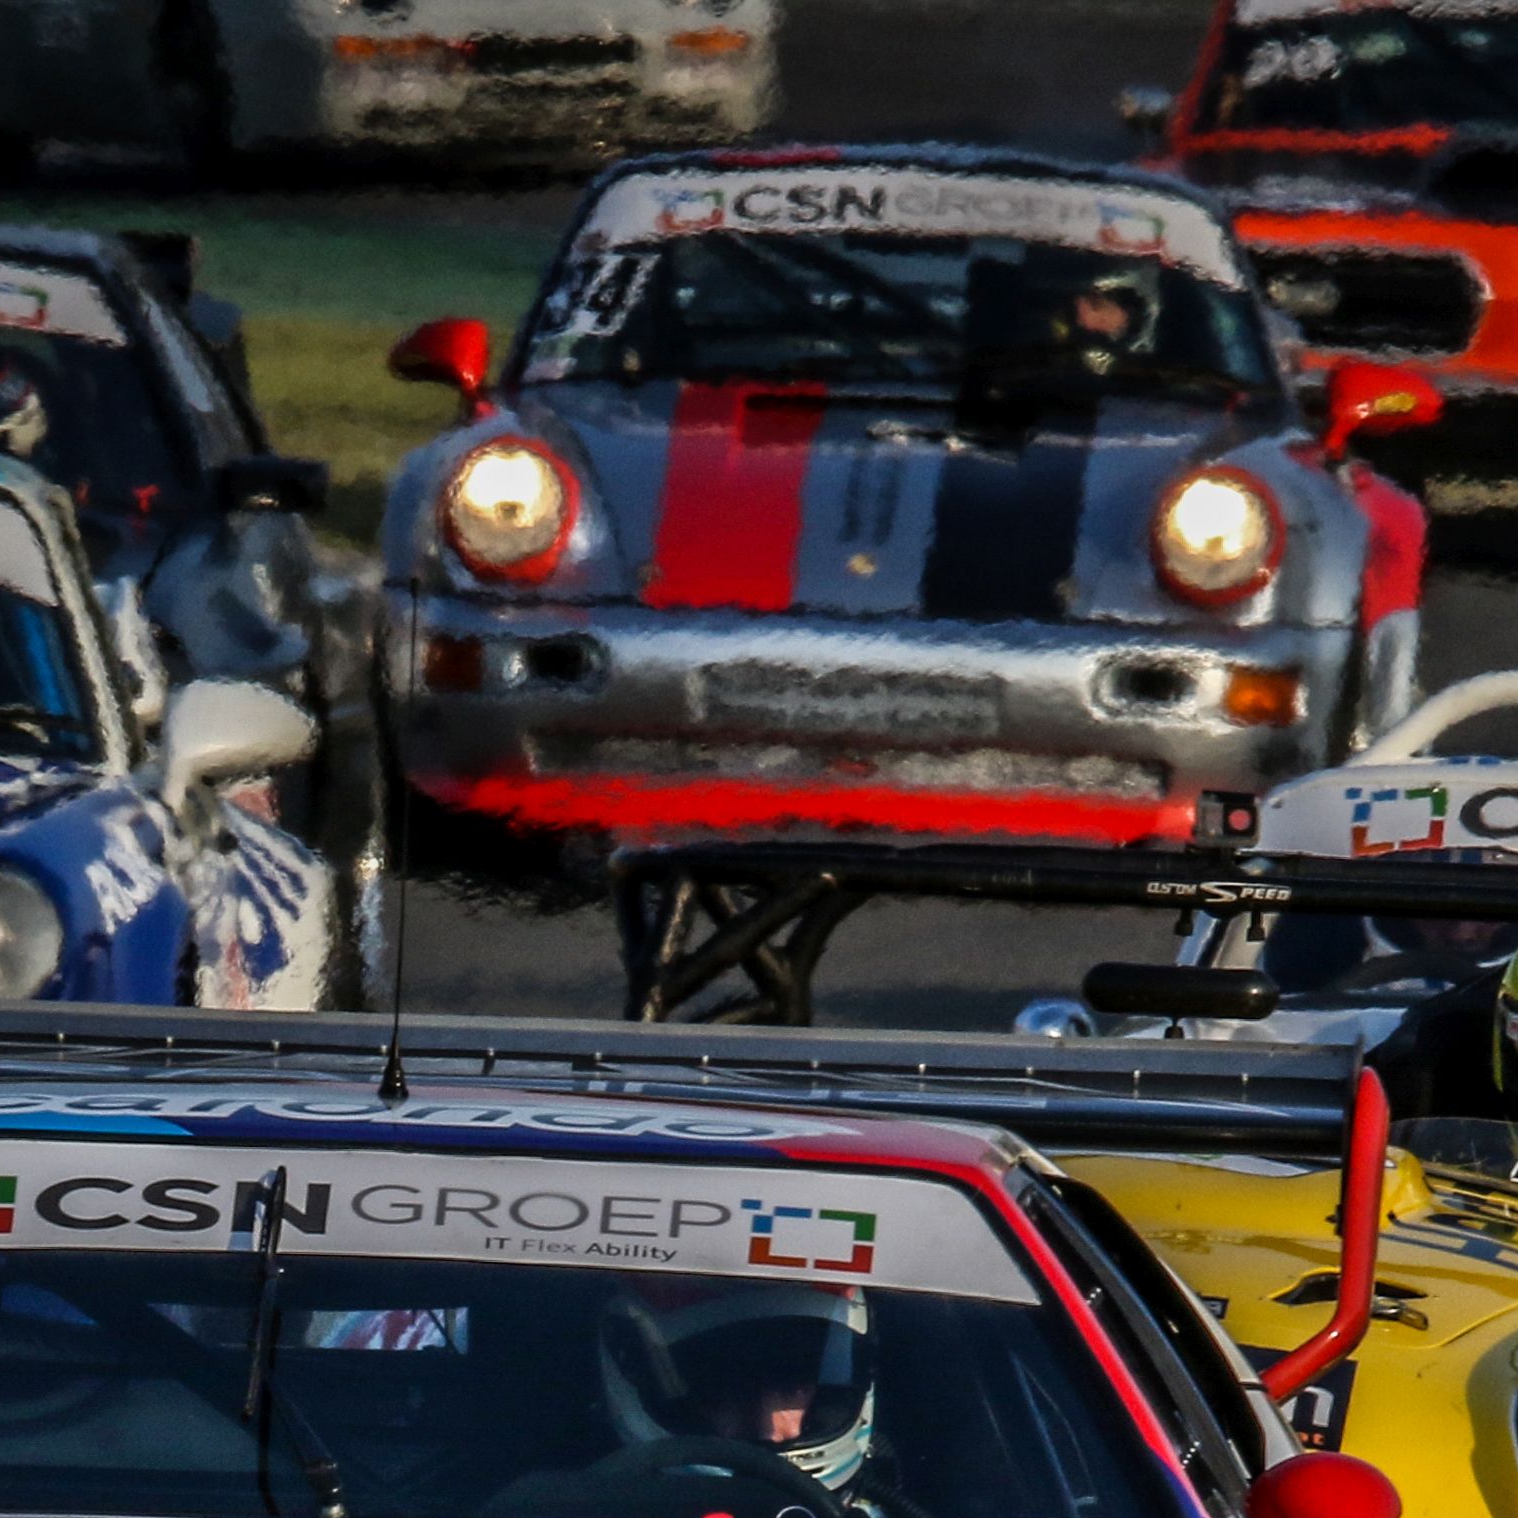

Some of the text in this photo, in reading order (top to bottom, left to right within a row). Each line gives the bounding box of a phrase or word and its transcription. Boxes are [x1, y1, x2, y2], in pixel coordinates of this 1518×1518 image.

[1199, 881, 1292, 902] SPEED
[484, 1236, 678, 1263] IT Flex Ability
